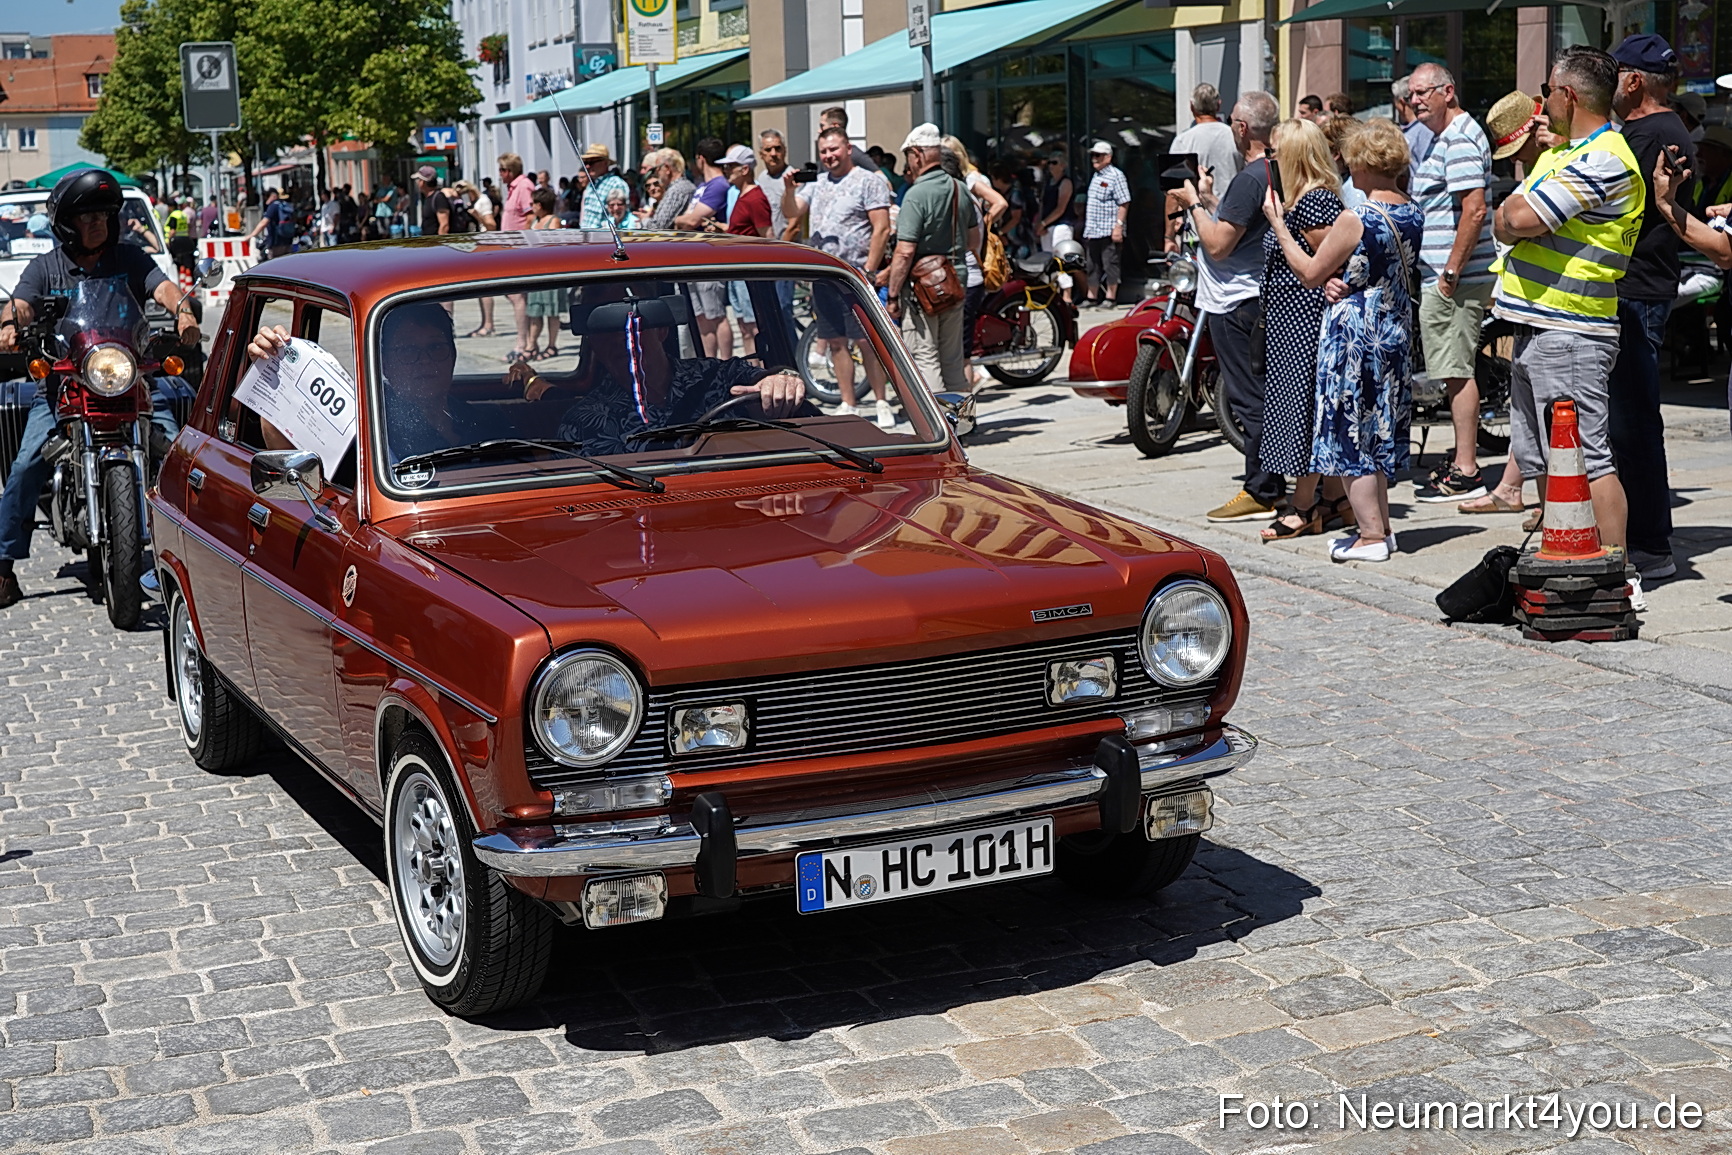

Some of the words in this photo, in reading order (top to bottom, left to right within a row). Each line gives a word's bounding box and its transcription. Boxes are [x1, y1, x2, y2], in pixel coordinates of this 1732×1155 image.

[589, 55, 606, 75] G2
[310, 377, 346, 416] 609
[1036, 606, 1090, 619] SIMCA
[825, 856, 851, 902] N
[882, 843, 936, 893] HC
[948, 824, 1051, 883] 101H
[807, 888, 816, 902] D
